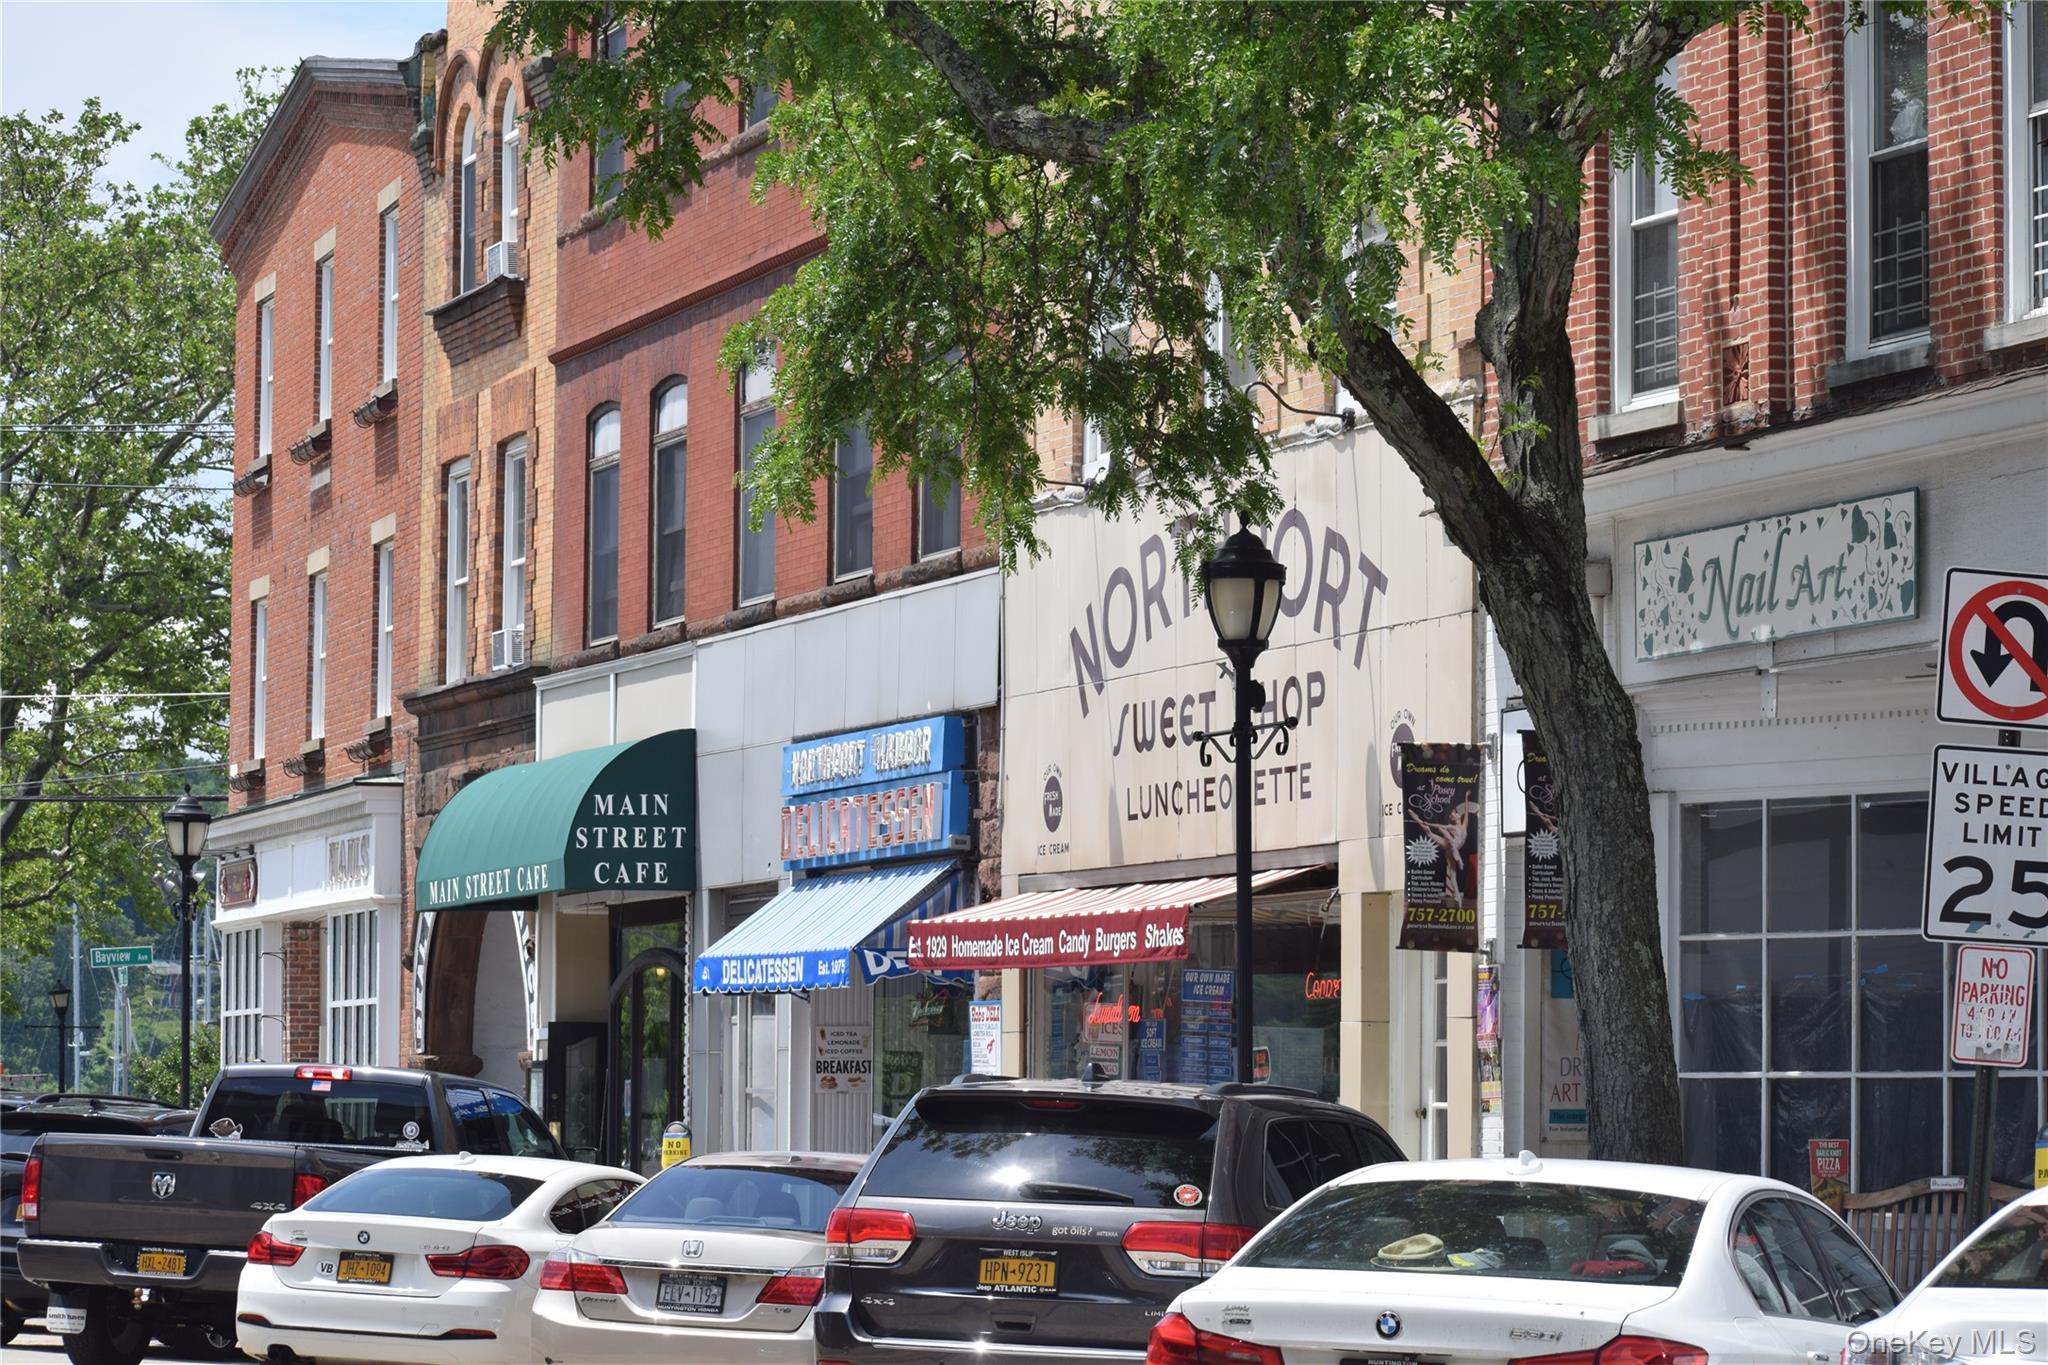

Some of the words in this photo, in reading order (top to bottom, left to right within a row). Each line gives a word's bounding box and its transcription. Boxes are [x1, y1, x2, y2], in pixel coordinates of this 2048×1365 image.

[1699, 526, 1792, 640] Nail
[1786, 551, 1848, 610] Art
[1113, 690, 1216, 757] SWEET
[1260, 670, 1325, 734] HOP
[1403, 708, 1415, 726] OWN
[1527, 752, 1547, 763] Drea
[1406, 763, 1436, 773] Dreams
[1440, 765, 1450, 773] do
[1942, 762, 2048, 789] VILLAG
[1127, 762, 1312, 821] LUNCHEOETTE
[1431, 780, 1455, 796] Posey
[594, 793, 669, 816] MAIN
[1382, 803, 1393, 816] ICE
[780, 783, 936, 860] DELICATESSEN
[575, 826, 687, 849] STREET
[1963, 822, 2042, 848] LIMIT
[1037, 845, 1046, 856] ICE
[1049, 842, 1069, 855] CREAM
[594, 862, 669, 884] CAFE
[429, 877, 459, 904] MAIN
[465, 868, 510, 900] STREET
[517, 863, 549, 893] CAFE
[1939, 856, 2048, 929] 25
[1408, 908, 1476, 923] 757-2700
[1528, 905, 1563, 919] 757-
[926, 935, 947, 958] 1929
[951, 933, 1003, 958] Homemade
[1005, 933, 1020, 956] Ice
[1021, 931, 1053, 956] Cream
[1058, 929, 1090, 959] Candy
[1095, 927, 1137, 957] Burgers
[1144, 923, 1185, 949] Shakes
[94, 950, 131, 965] Bayview
[137, 953, 148, 962] Ave
[722, 956, 804, 985] DELICATESSEN
[831, 959, 846, 975] 1975
[1981, 957, 2008, 979] NO
[1185, 972, 1198, 982] OUR
[1200, 973, 1213, 982] OWN
[1214, 973, 1231, 983] MADE
[1193, 984, 1203, 994] ICE
[1205, 985, 1225, 995] CREAM
[1961, 982, 2025, 1007] PARKING
[1101, 1022, 1123, 1035] ICES
[1146, 1028, 1157, 1038] SOFT
[1091, 1047, 1118, 1057] LEMON
[816, 1060, 872, 1074] BREAKFAST
[1104, 1064, 1118, 1073] NGO
[668, 1141, 682, 1149] NO
[1817, 1157, 1841, 1170] PIZZA
[992, 1210, 1042, 1234] Jeep
[1051, 1226, 1068, 1236] got
[321, 1262, 334, 1273] VB
[994, 1285, 1037, 1293] ATLANTIC
[1144, 1309, 1165, 1317] LIMI
